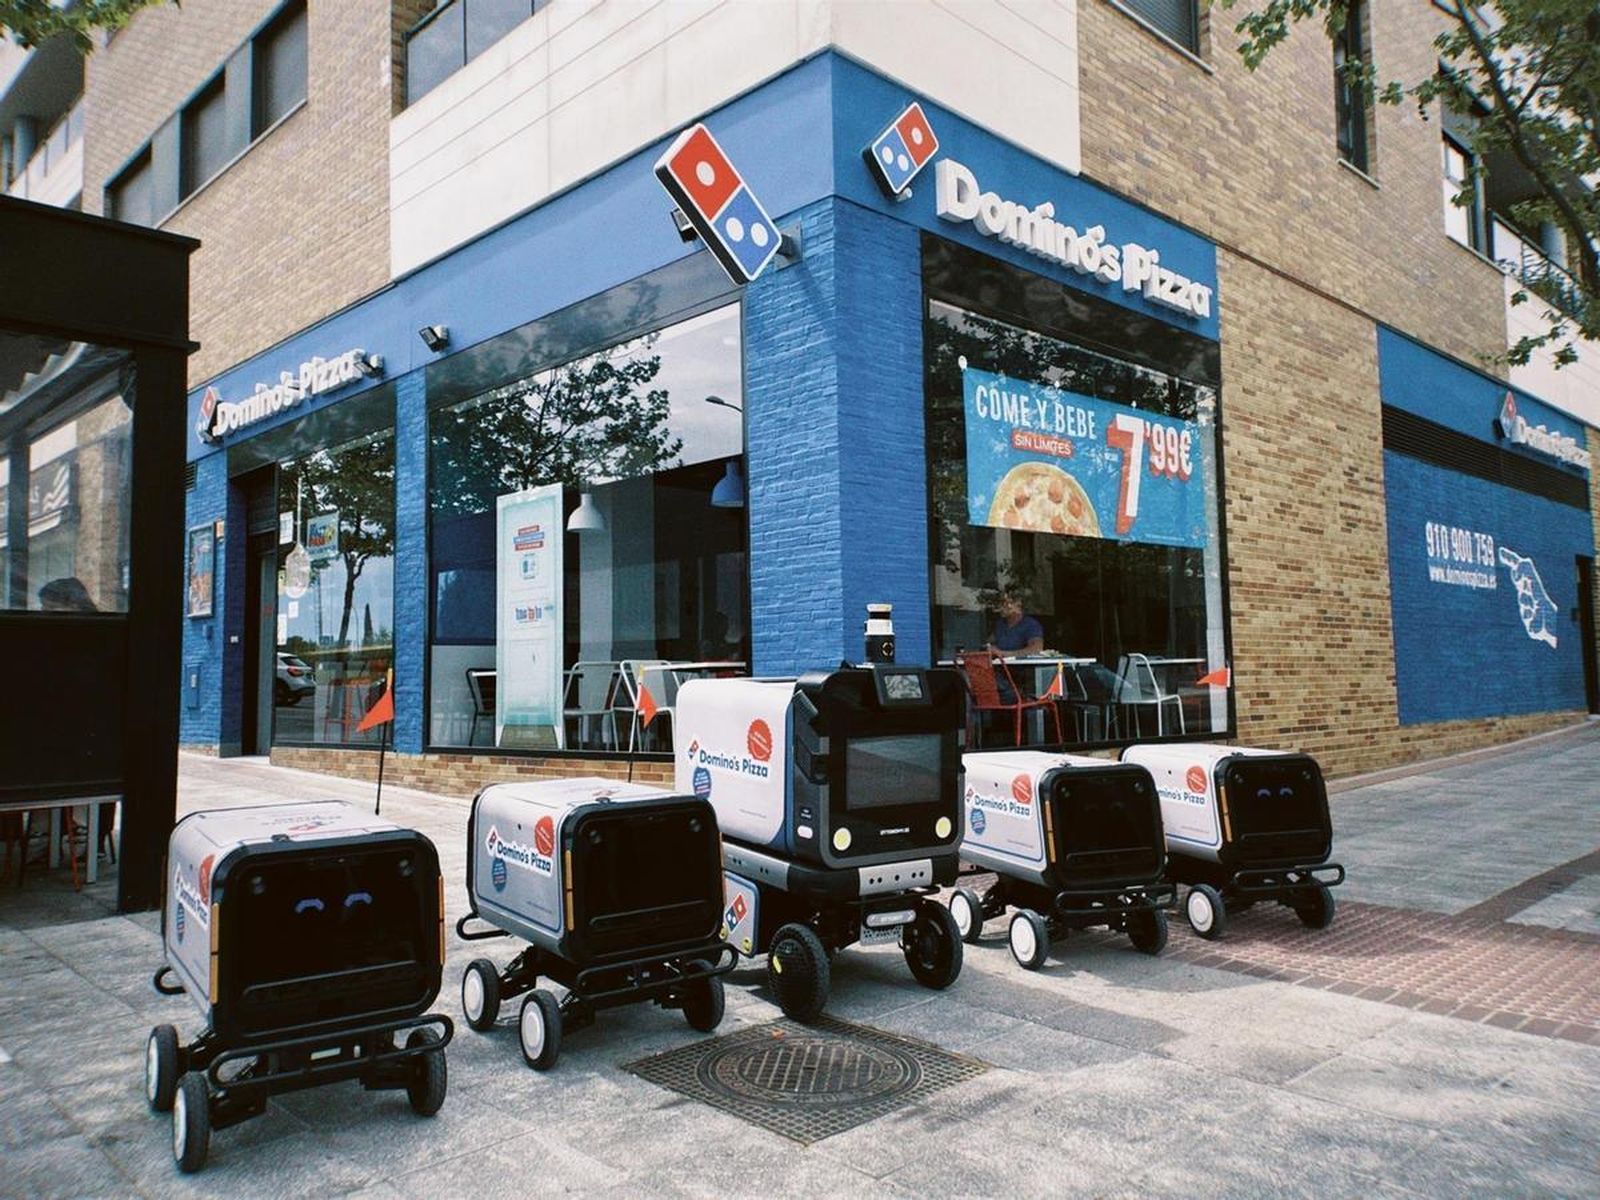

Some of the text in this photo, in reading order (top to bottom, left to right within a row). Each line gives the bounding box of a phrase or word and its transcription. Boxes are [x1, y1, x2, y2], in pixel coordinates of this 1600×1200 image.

[935, 158, 1212, 318] Domino's Pizza
[212, 355, 362, 437] Domino's Pizza
[975, 385, 1097, 440] COME Y BEBE
[1015, 433, 1071, 456] SIN LIMITES
[1425, 521, 1449, 559] 910
[1451, 527, 1473, 563] 900
[699, 749, 769, 778] Domino's Pizza
[974, 794, 1031, 817] Domino's Pizza
[1158, 787, 1205, 805] mino's Pizza
[497, 840, 530, 864] Domino's
[531, 852, 551, 873] Pizza
